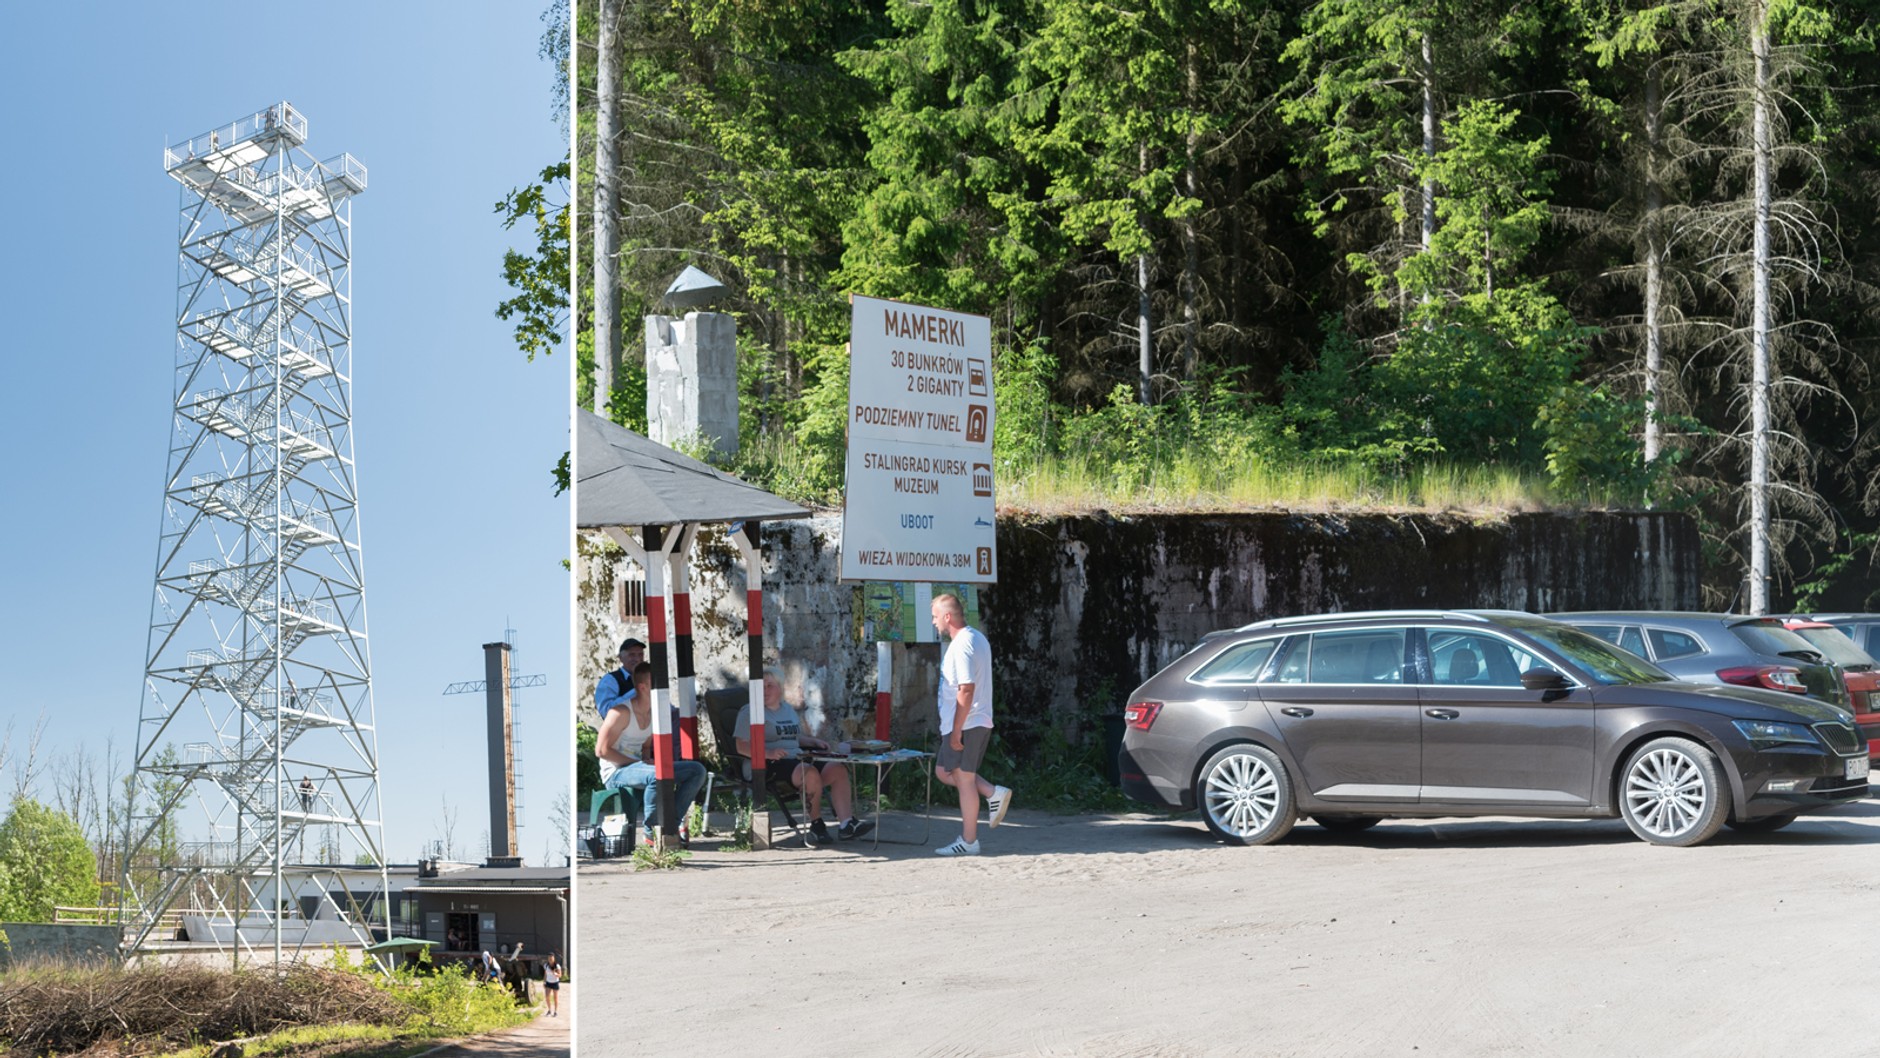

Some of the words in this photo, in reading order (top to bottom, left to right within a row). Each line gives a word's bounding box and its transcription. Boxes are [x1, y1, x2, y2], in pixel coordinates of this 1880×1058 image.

[884, 308, 965, 347] MAMERKI
[891, 350, 905, 368] 30
[907, 352, 964, 376] BUNKRÓW
[907, 374, 915, 392] 2
[916, 375, 964, 398] GIGANTY
[855, 405, 924, 429] PODZIEMNY
[926, 412, 961, 433] TUNEL
[864, 452, 930, 473] STALINGRAD
[932, 458, 967, 476] KURSK
[894, 476, 939, 495] MUZEUM
[900, 513, 934, 530] UBOOT
[895, 551, 951, 567] WIDOKOWA
[952, 553, 971, 568] 38M
